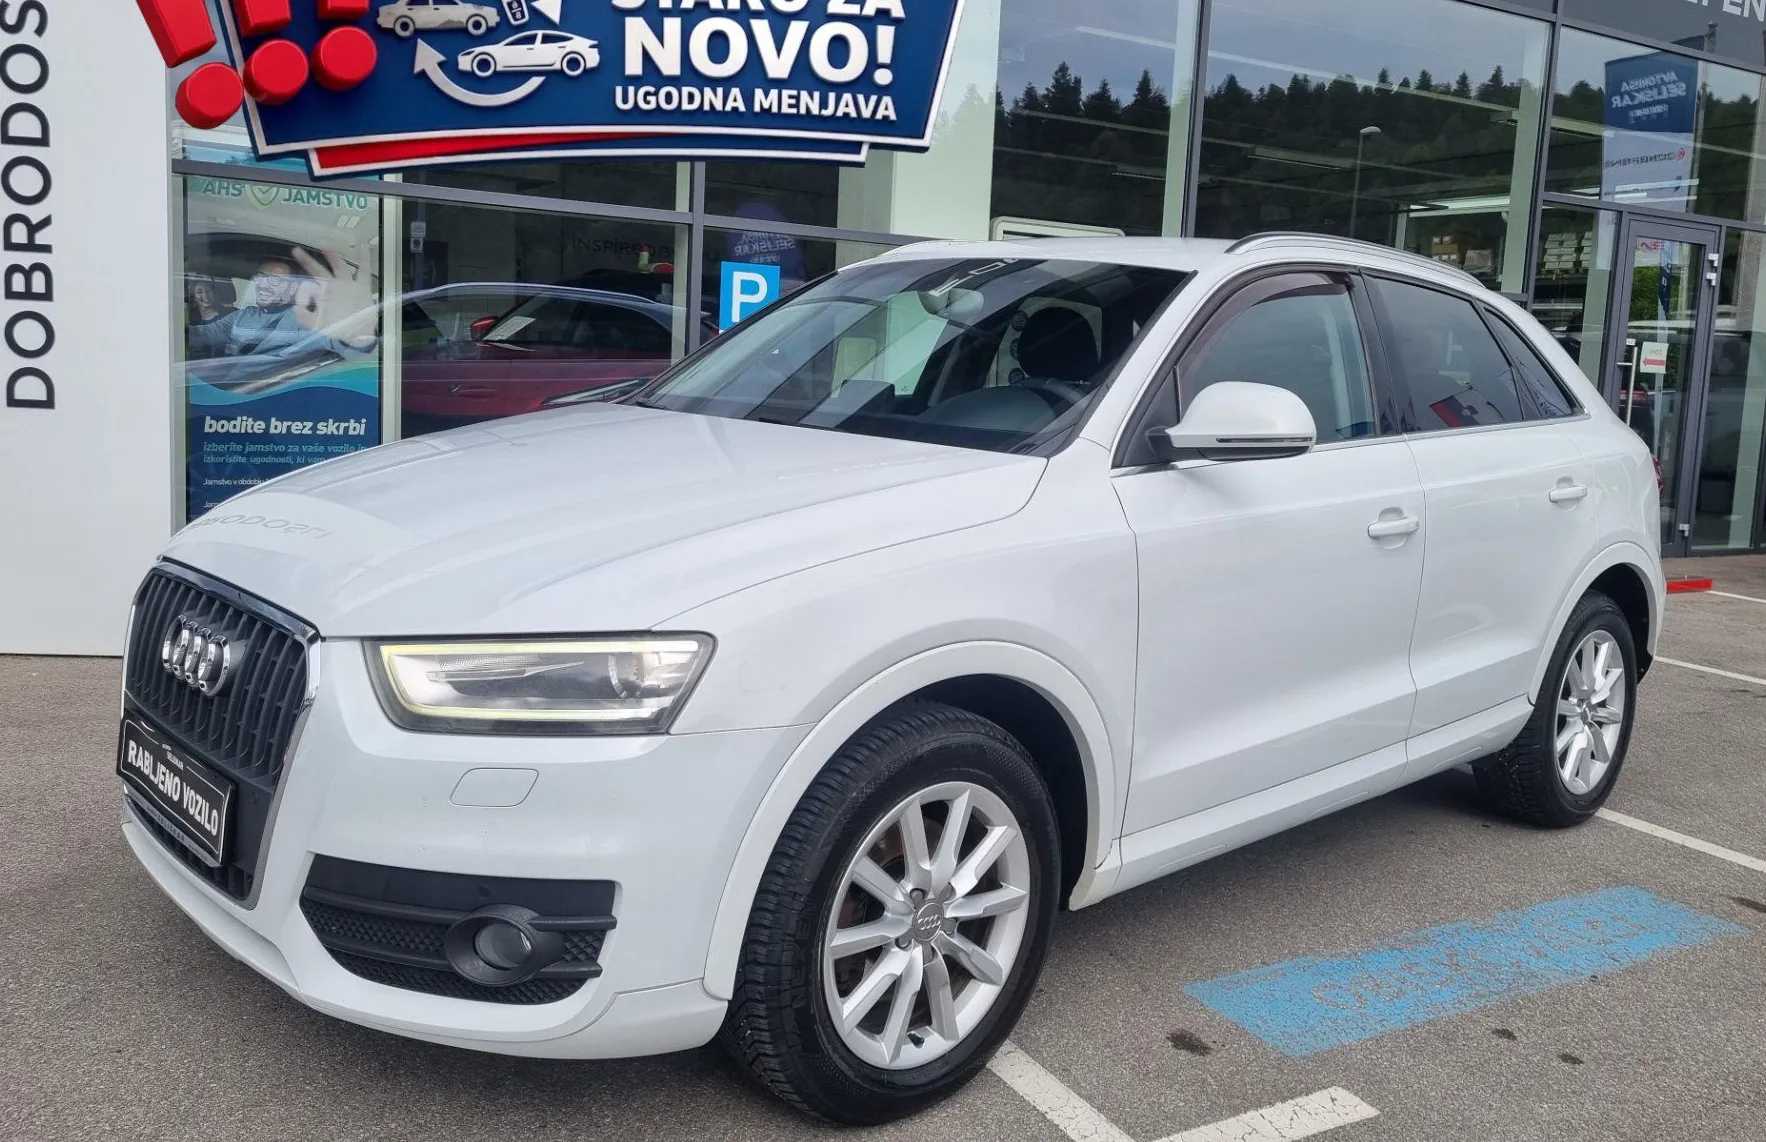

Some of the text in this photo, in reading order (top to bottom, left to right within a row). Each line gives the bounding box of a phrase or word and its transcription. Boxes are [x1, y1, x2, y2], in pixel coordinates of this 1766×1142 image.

[281, 188, 368, 210] JAMSTVO
[731, 271, 768, 323] P
[204, 416, 366, 436] bodite brez skrbi
[203, 442, 244, 452] izberite
[245, 442, 285, 454] jamstvo
[288, 444, 299, 452] za
[302, 443, 324, 453] vaše
[203, 455, 247, 463] izkoristite
[250, 455, 293, 464] ugodnosti,
[296, 455, 305, 463] ki
[127, 739, 219, 836] RABLJENO VOZILO
